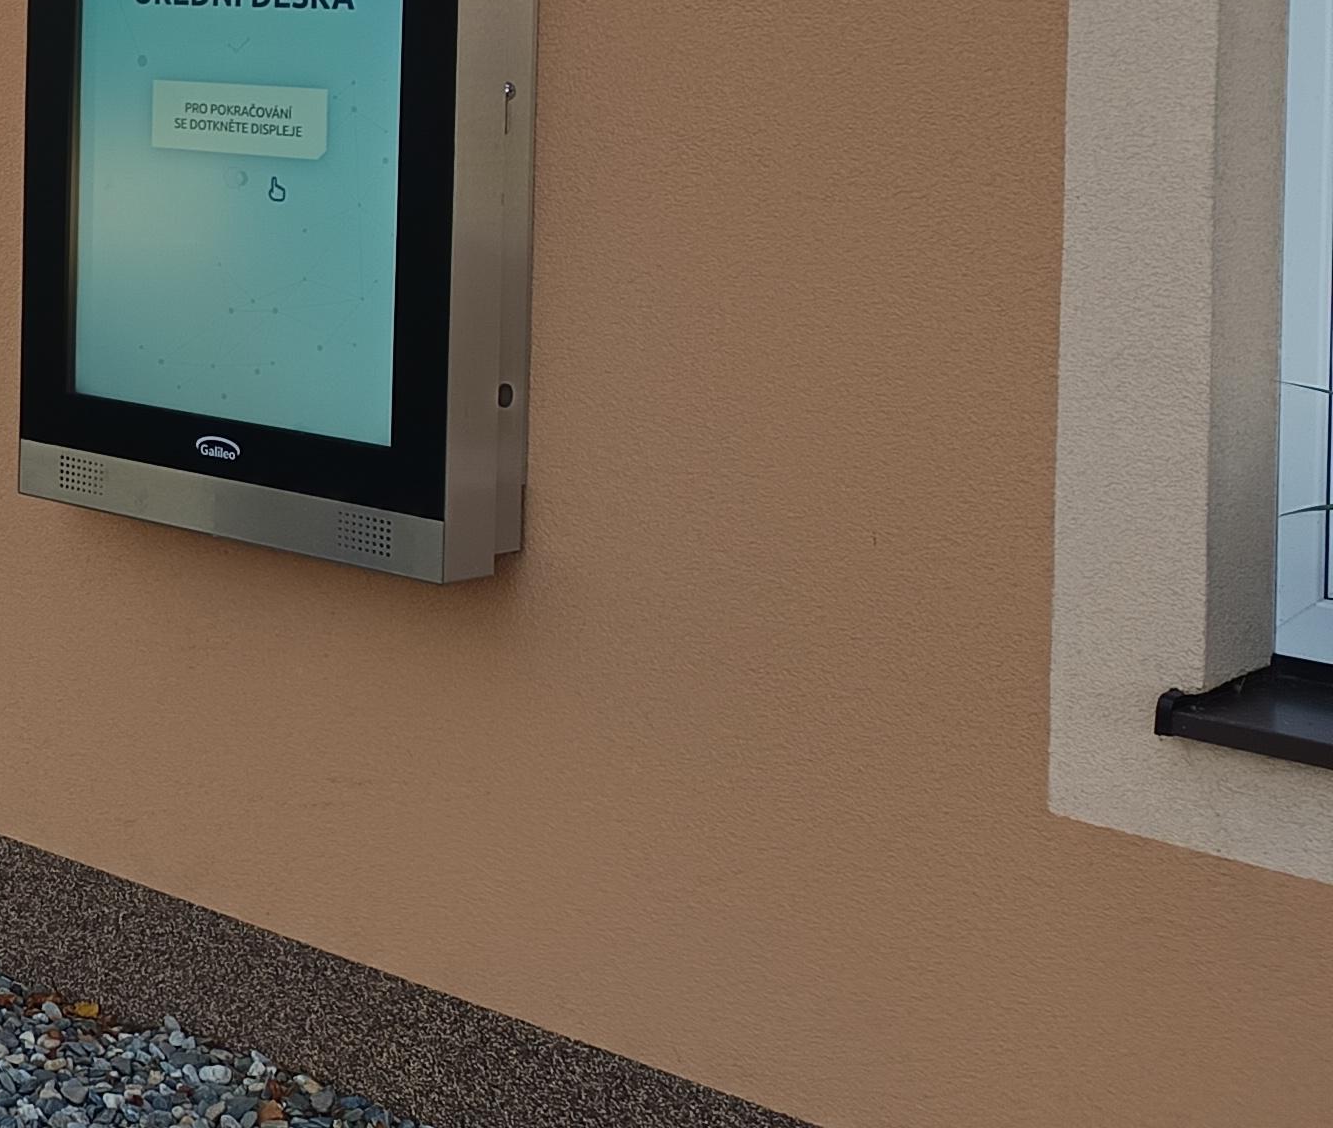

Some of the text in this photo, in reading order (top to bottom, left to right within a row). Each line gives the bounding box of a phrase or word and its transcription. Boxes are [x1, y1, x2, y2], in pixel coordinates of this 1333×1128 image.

[185, 102, 293, 120] PRO POKRAČOVÁNÍ
[174, 117, 303, 138] SE DOTKNĚTE DISPLEJE
[200, 444, 236, 460] Galileo
